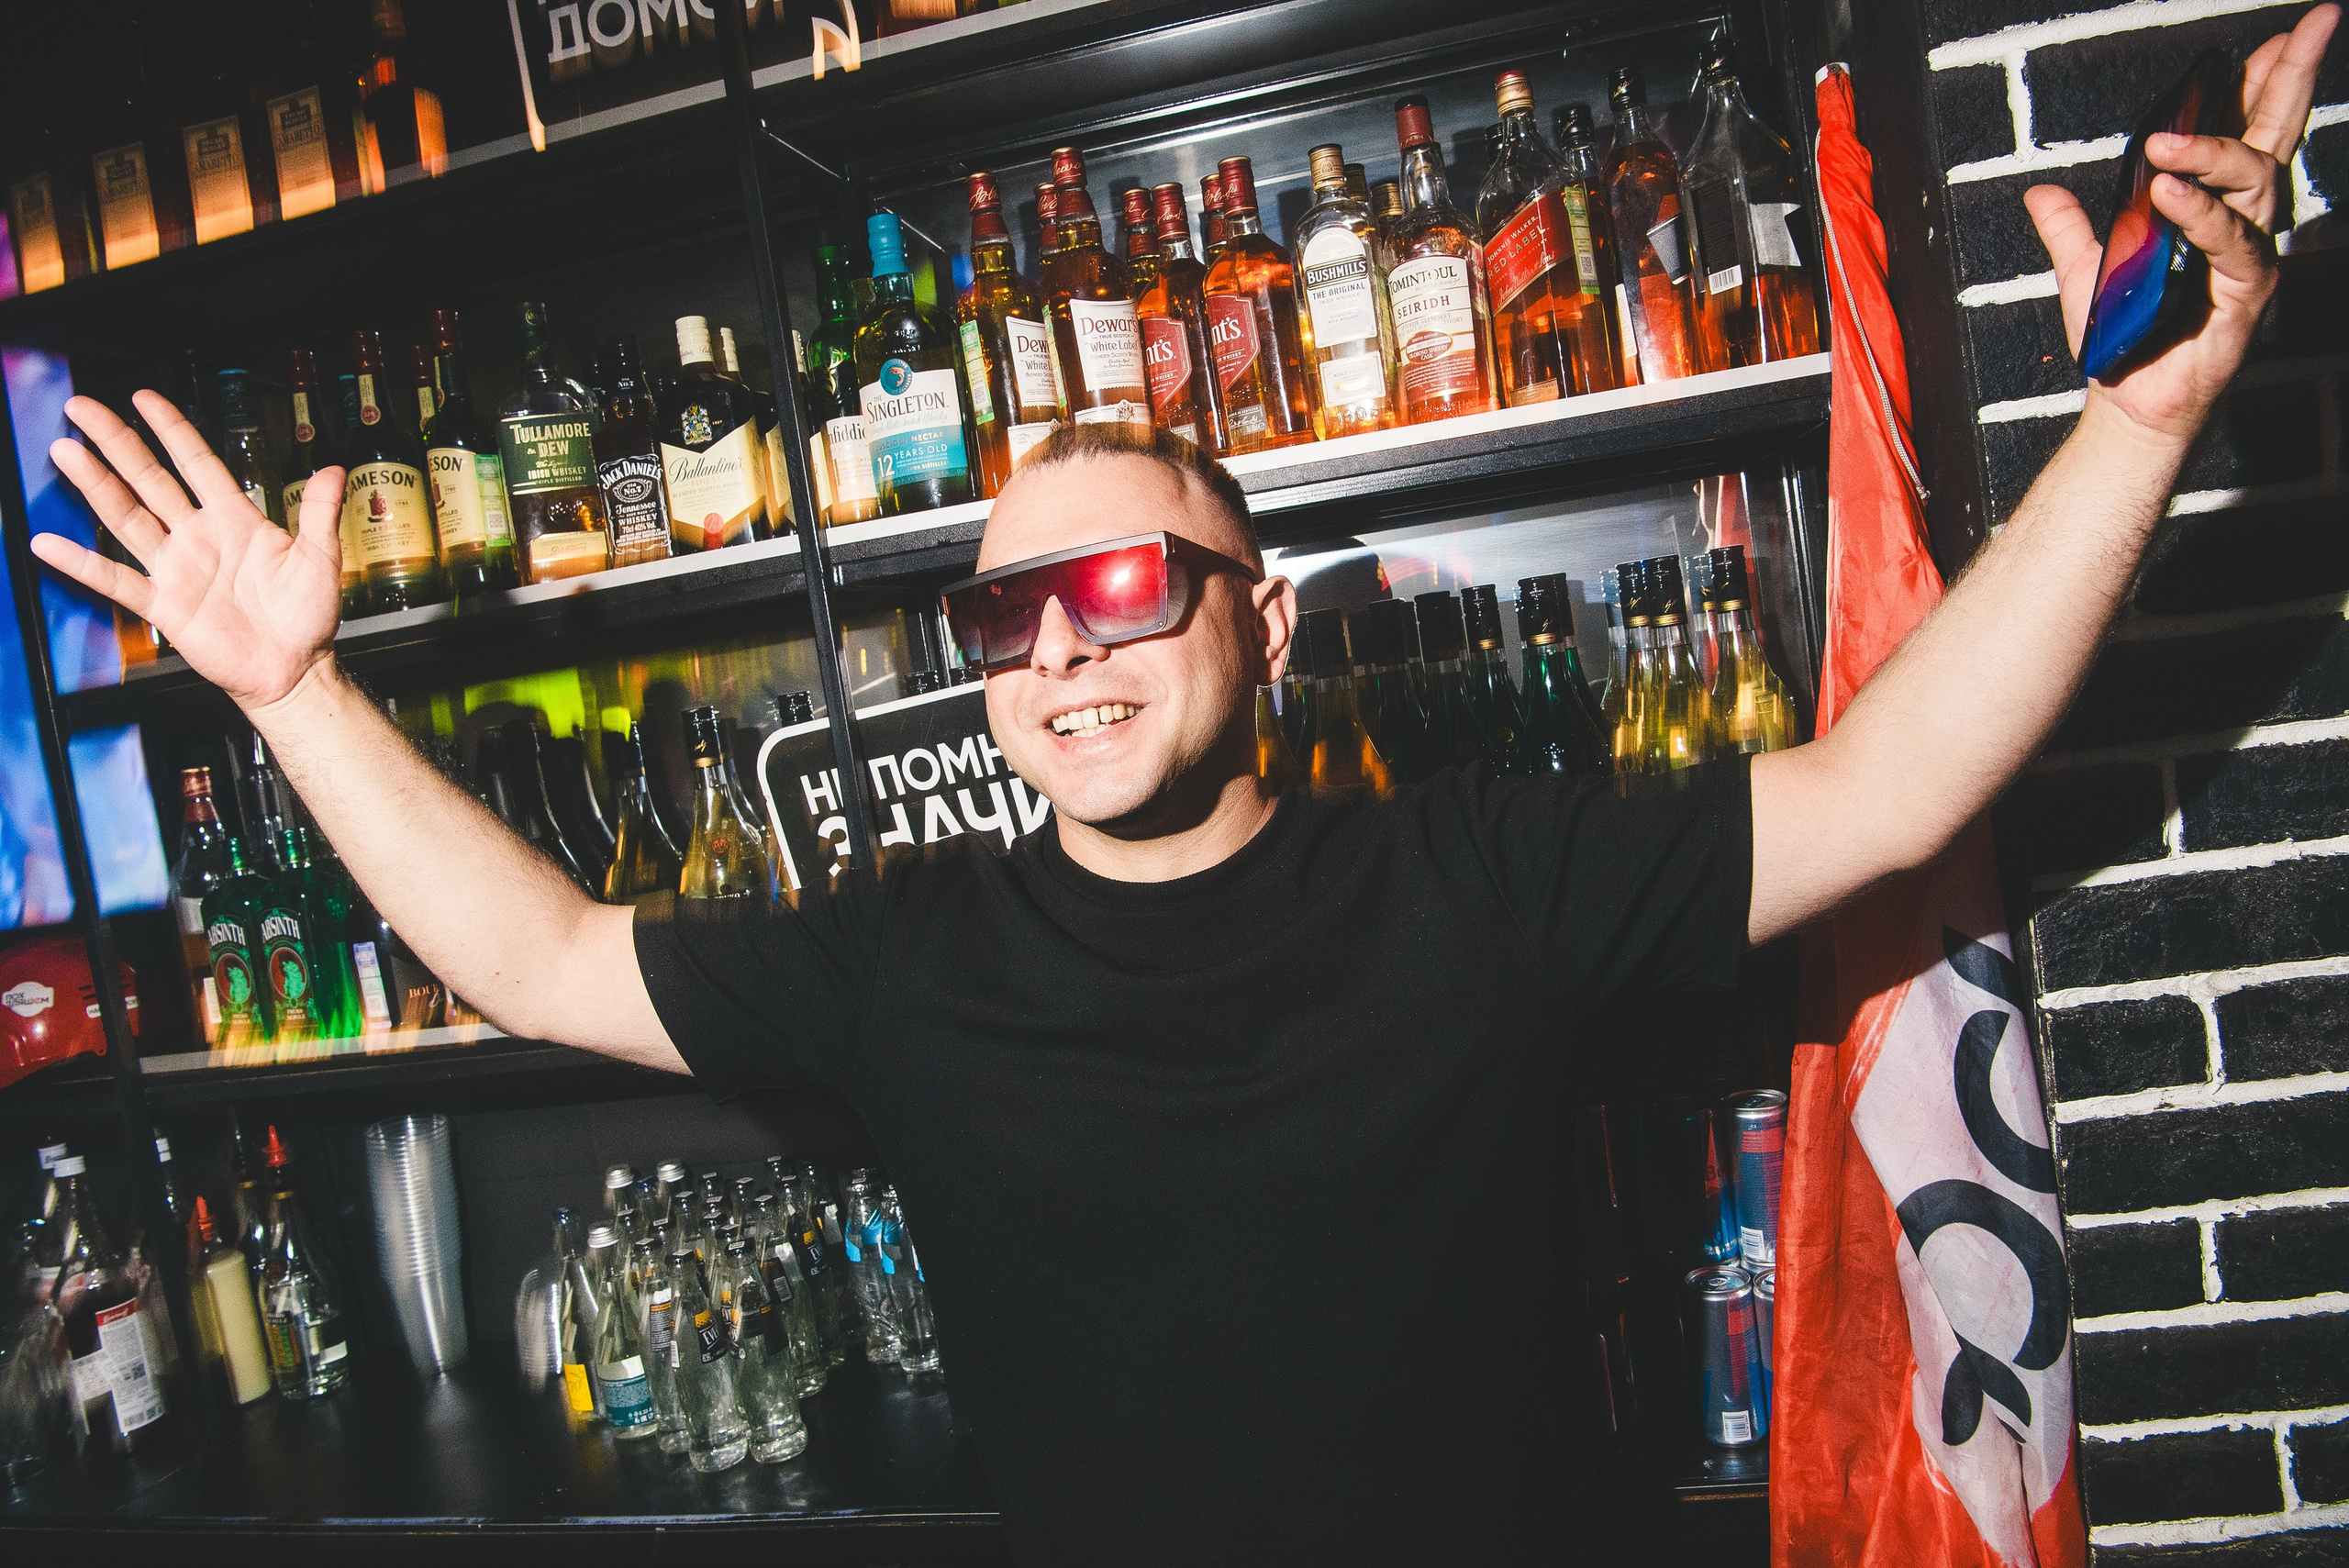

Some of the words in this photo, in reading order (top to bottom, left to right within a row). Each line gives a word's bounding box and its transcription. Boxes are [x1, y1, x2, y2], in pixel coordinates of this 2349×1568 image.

[1486, 238, 1512, 265] JOHNNIE
[1307, 261, 1367, 284] BUSHMILLS
[1487, 257, 1508, 279] RED
[1389, 265, 1457, 295] TOMINTOUL
[1312, 290, 1327, 300] THE
[1329, 283, 1366, 296] ORIGINAL
[1397, 295, 1451, 318] SEIRIDH
[1080, 317, 1138, 336] Dewar's
[1420, 313, 1452, 324] GLENLIVET
[1409, 349, 1428, 359] OLOROSO
[1429, 344, 1448, 353] SHERRY
[866, 392, 946, 424] SINGLETON
[509, 422, 591, 445] TULLAMORE
[911, 431, 943, 442] NECTAR
[894, 447, 924, 460] YEARS
[927, 443, 948, 453] OLD
[528, 469, 551, 480] IRISH
[551, 466, 587, 476] WHISKEY
[600, 466, 624, 490] JACK
[622, 461, 663, 480] DANIEL'S
[669, 457, 744, 484] Ballantine's
[877, 454, 896, 477] 12
[555, 475, 583, 484] DISTILLED
[623, 485, 642, 496] No.7
[672, 489, 697, 498] BLENDED
[698, 484, 721, 493] SCOTCH
[616, 501, 657, 514] Tennessee
[618, 513, 657, 526] WHISKEY
[622, 525, 634, 534] 70cl
[800, 767, 844, 816] Н
[206, 922, 246, 947] ABSINTH
[261, 916, 301, 943] ABSINTH
